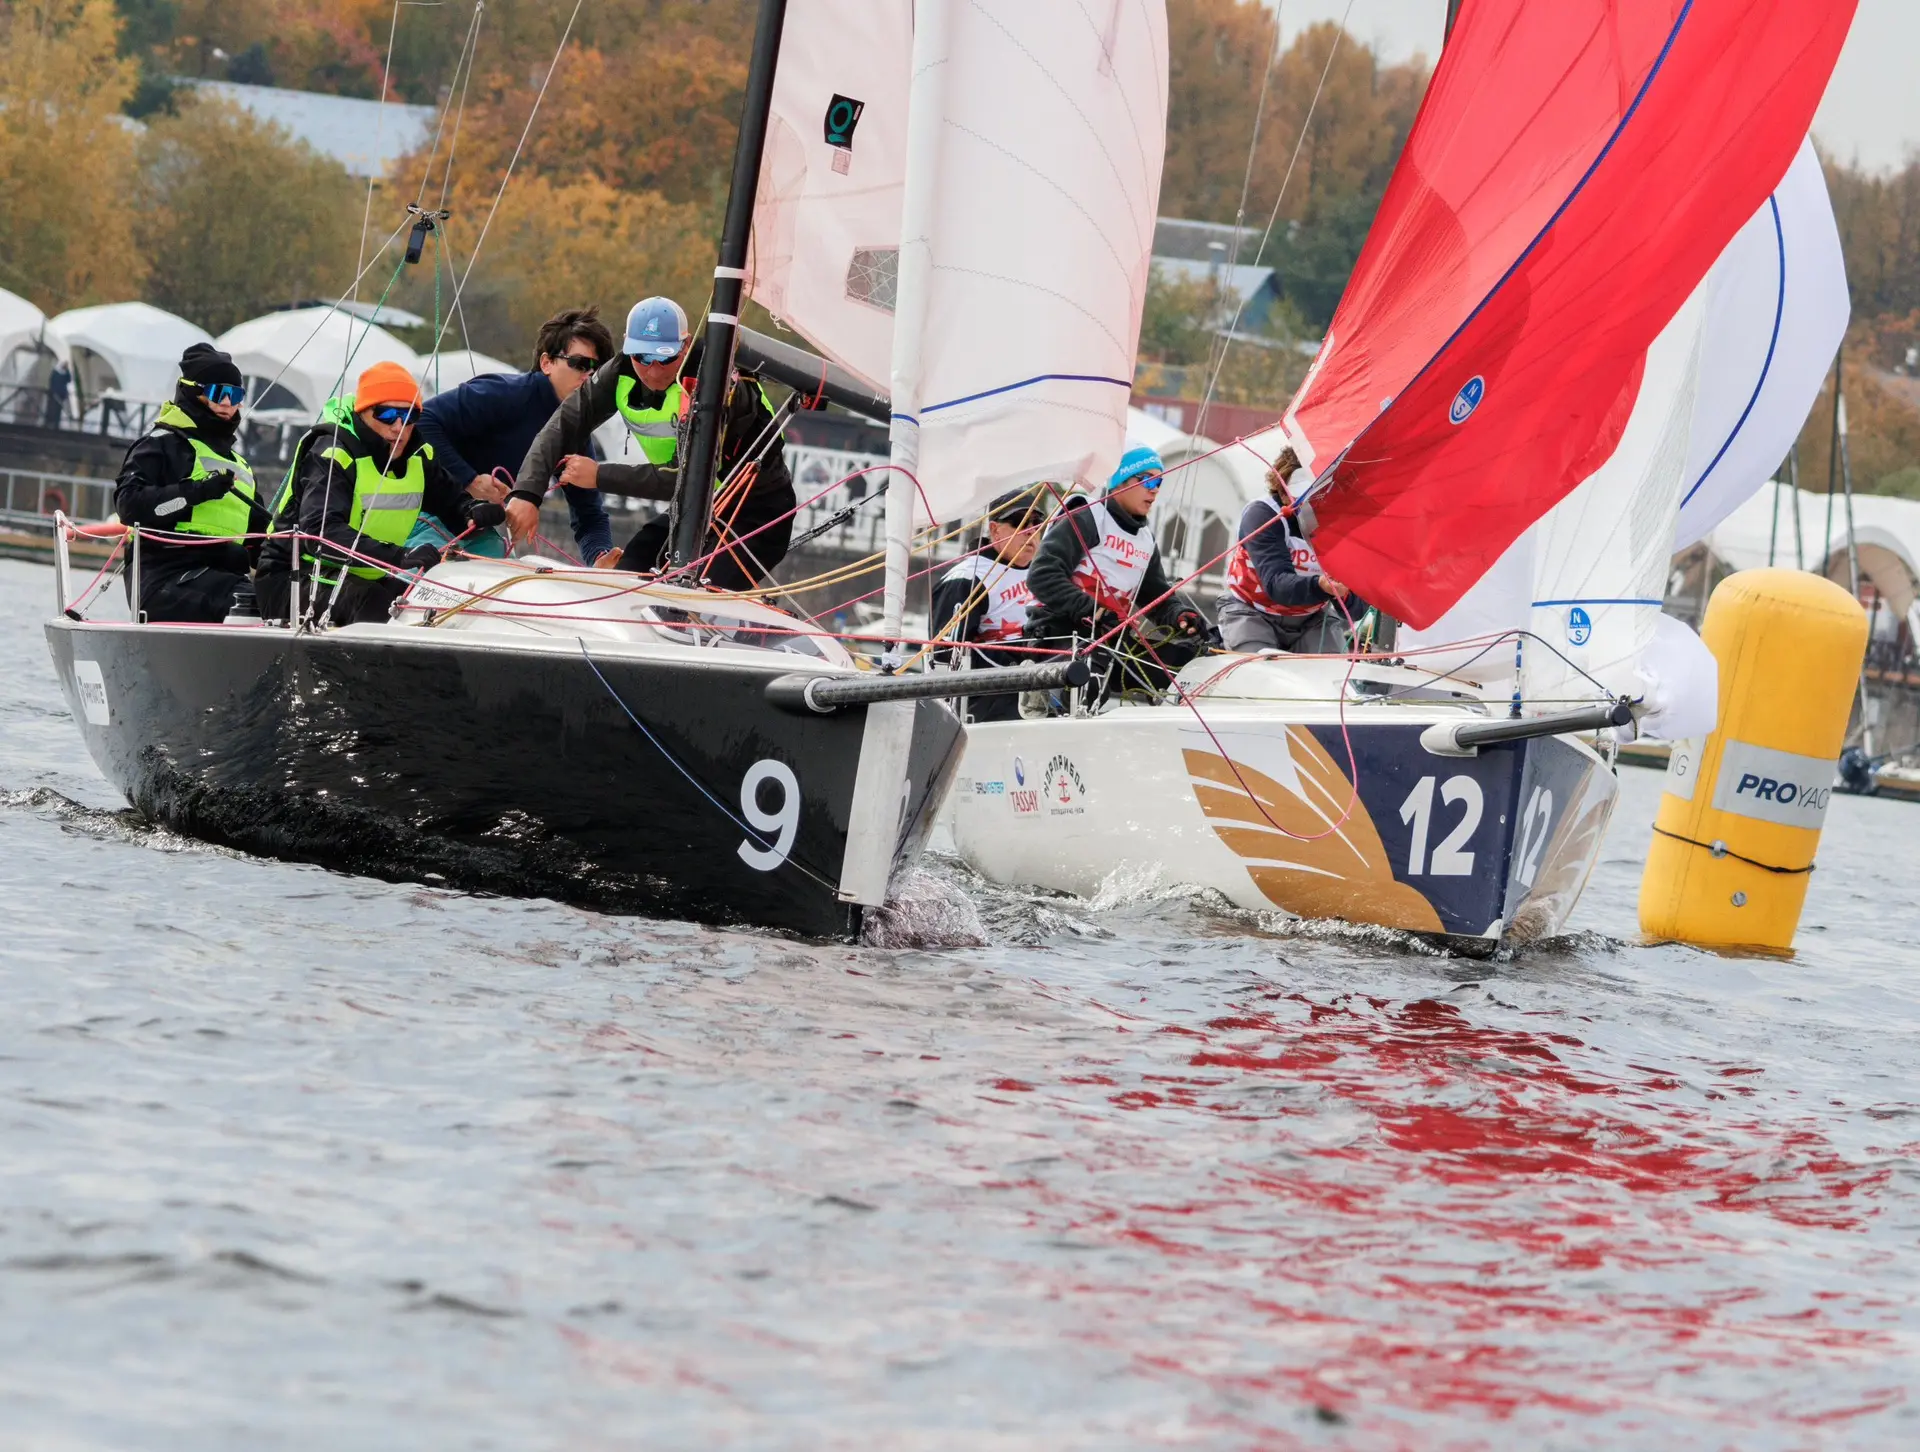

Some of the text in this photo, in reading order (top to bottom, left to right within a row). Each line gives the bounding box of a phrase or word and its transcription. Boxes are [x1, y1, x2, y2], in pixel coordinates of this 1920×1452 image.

[736, 758, 800, 872] 9
[1010, 789, 1039, 813] TASSAY
[1399, 774, 1484, 876] 12
[1514, 785, 1553, 888] 12
